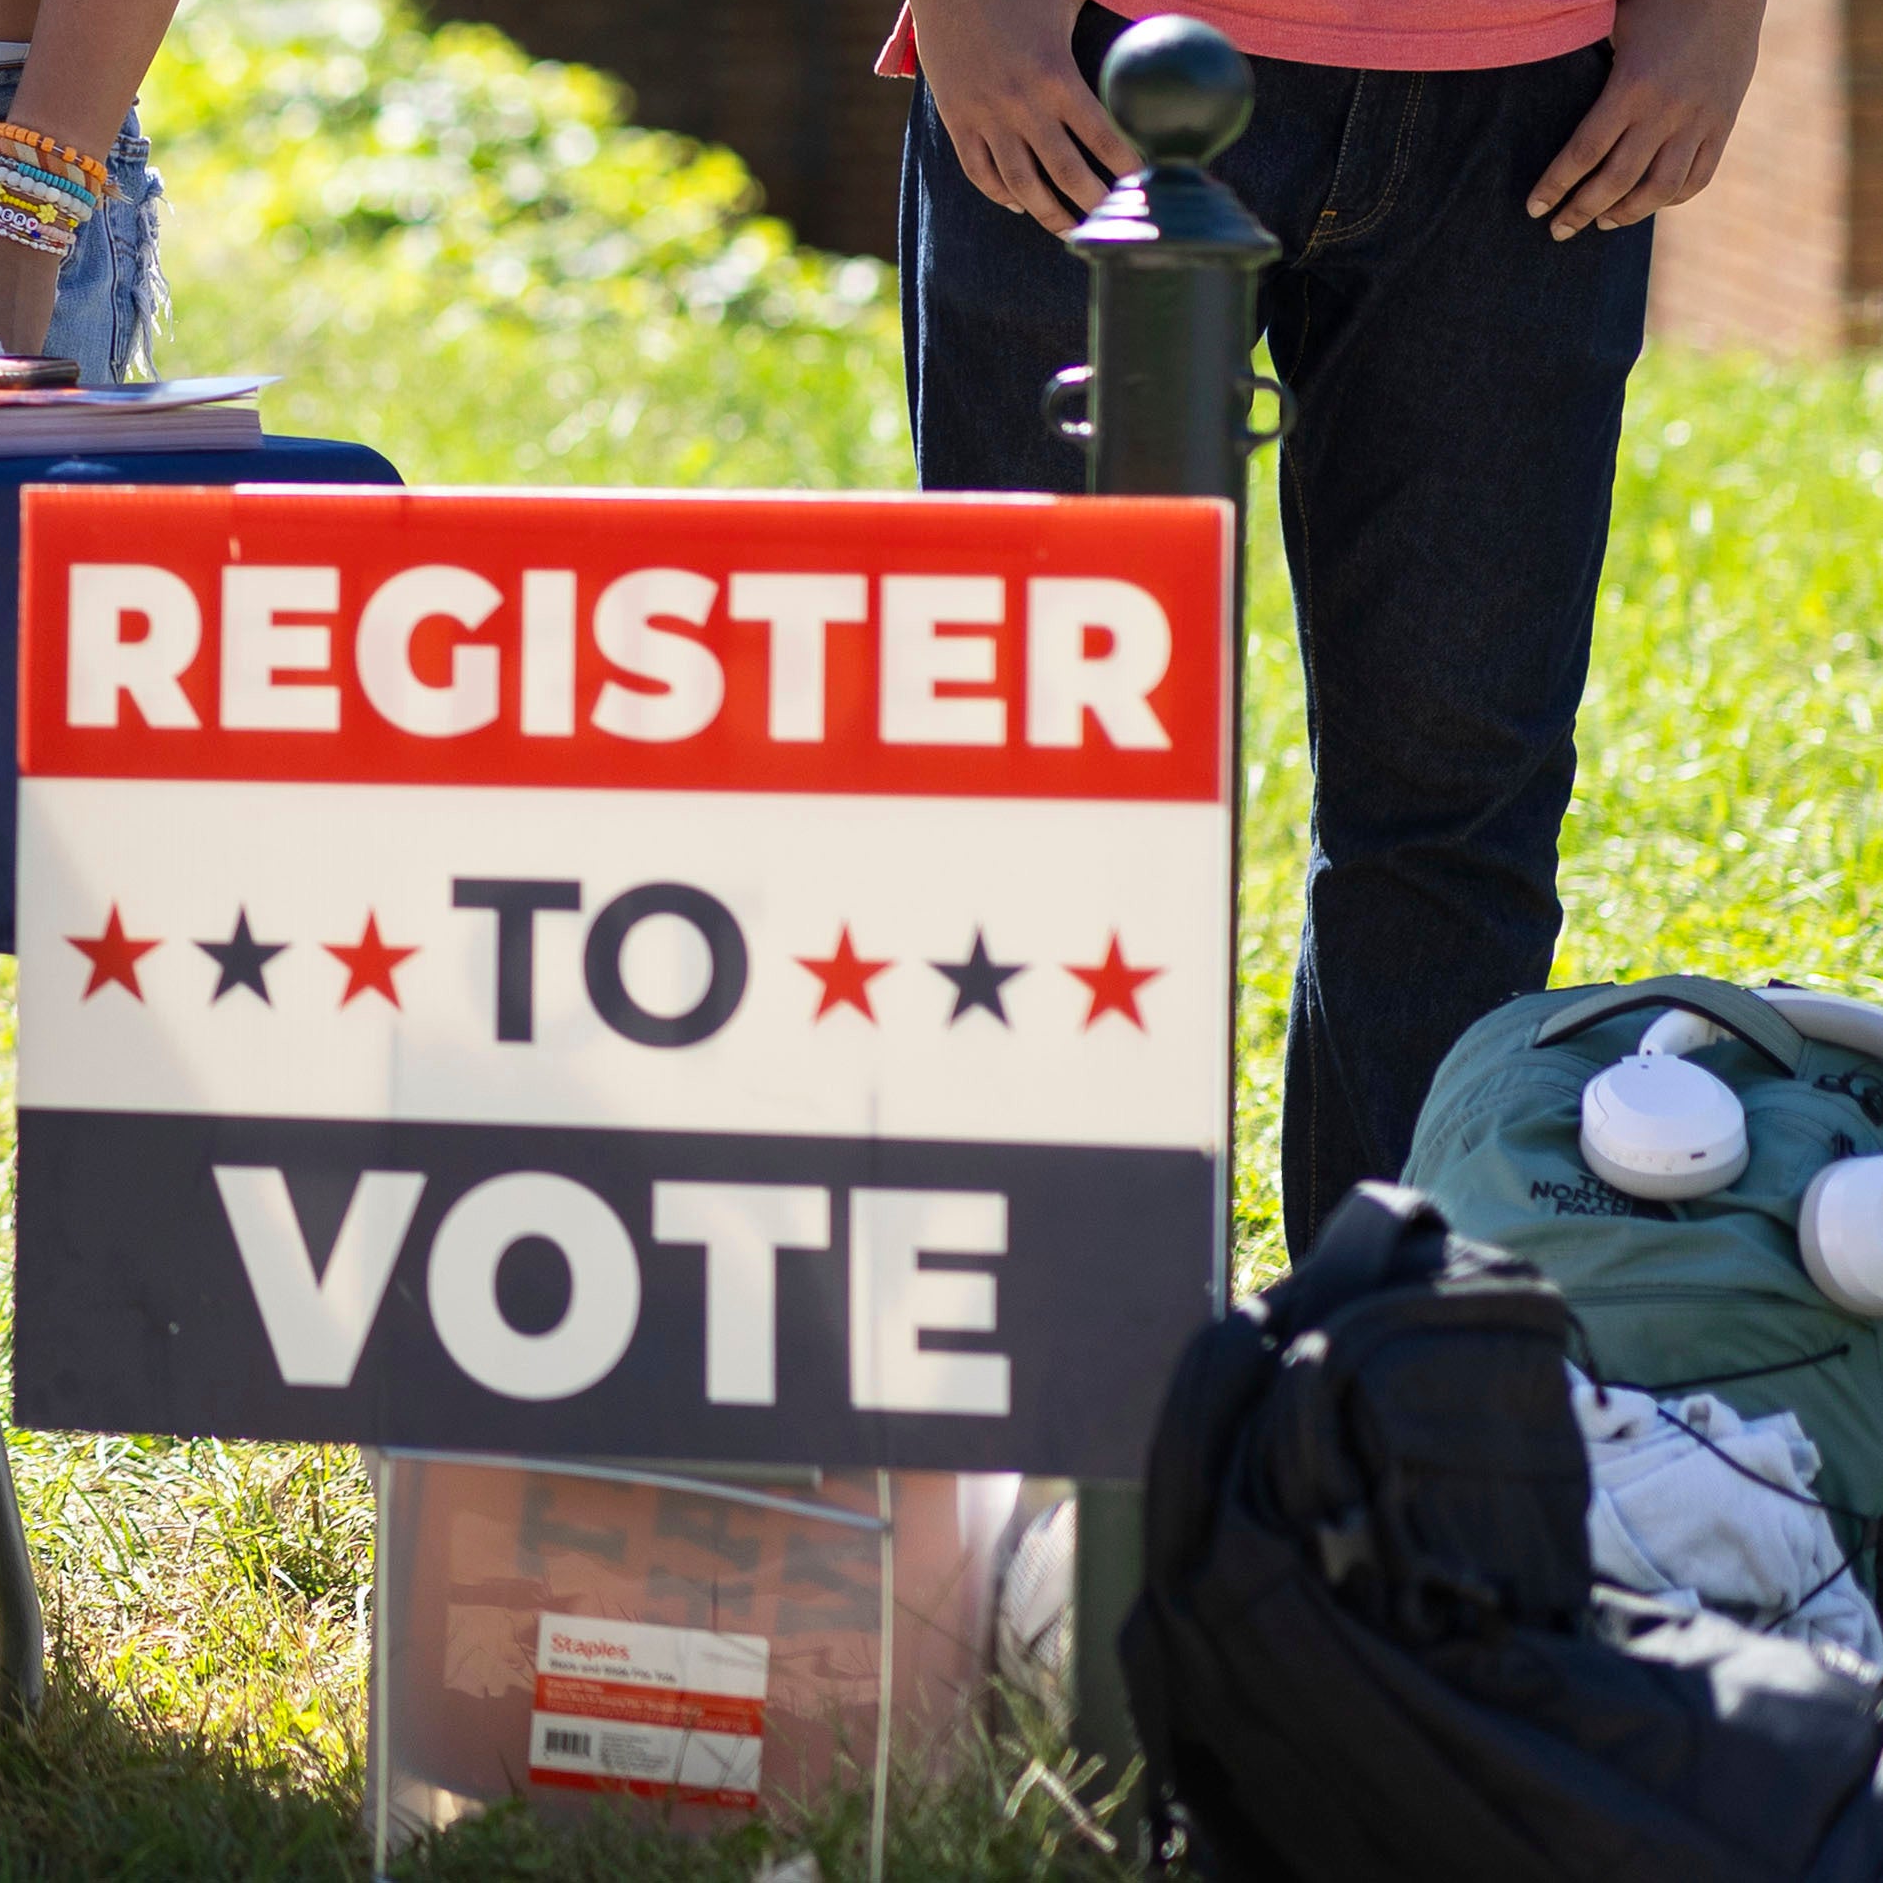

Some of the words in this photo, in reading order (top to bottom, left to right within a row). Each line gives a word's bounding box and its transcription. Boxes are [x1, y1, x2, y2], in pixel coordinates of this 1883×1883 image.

[66, 563, 1172, 751] REGISTER
[451, 876, 749, 1049] TO
[1577, 1174, 1614, 1196] TH
[213, 1164, 1011, 1417] VOTE
[550, 1632, 630, 1660] Staples
